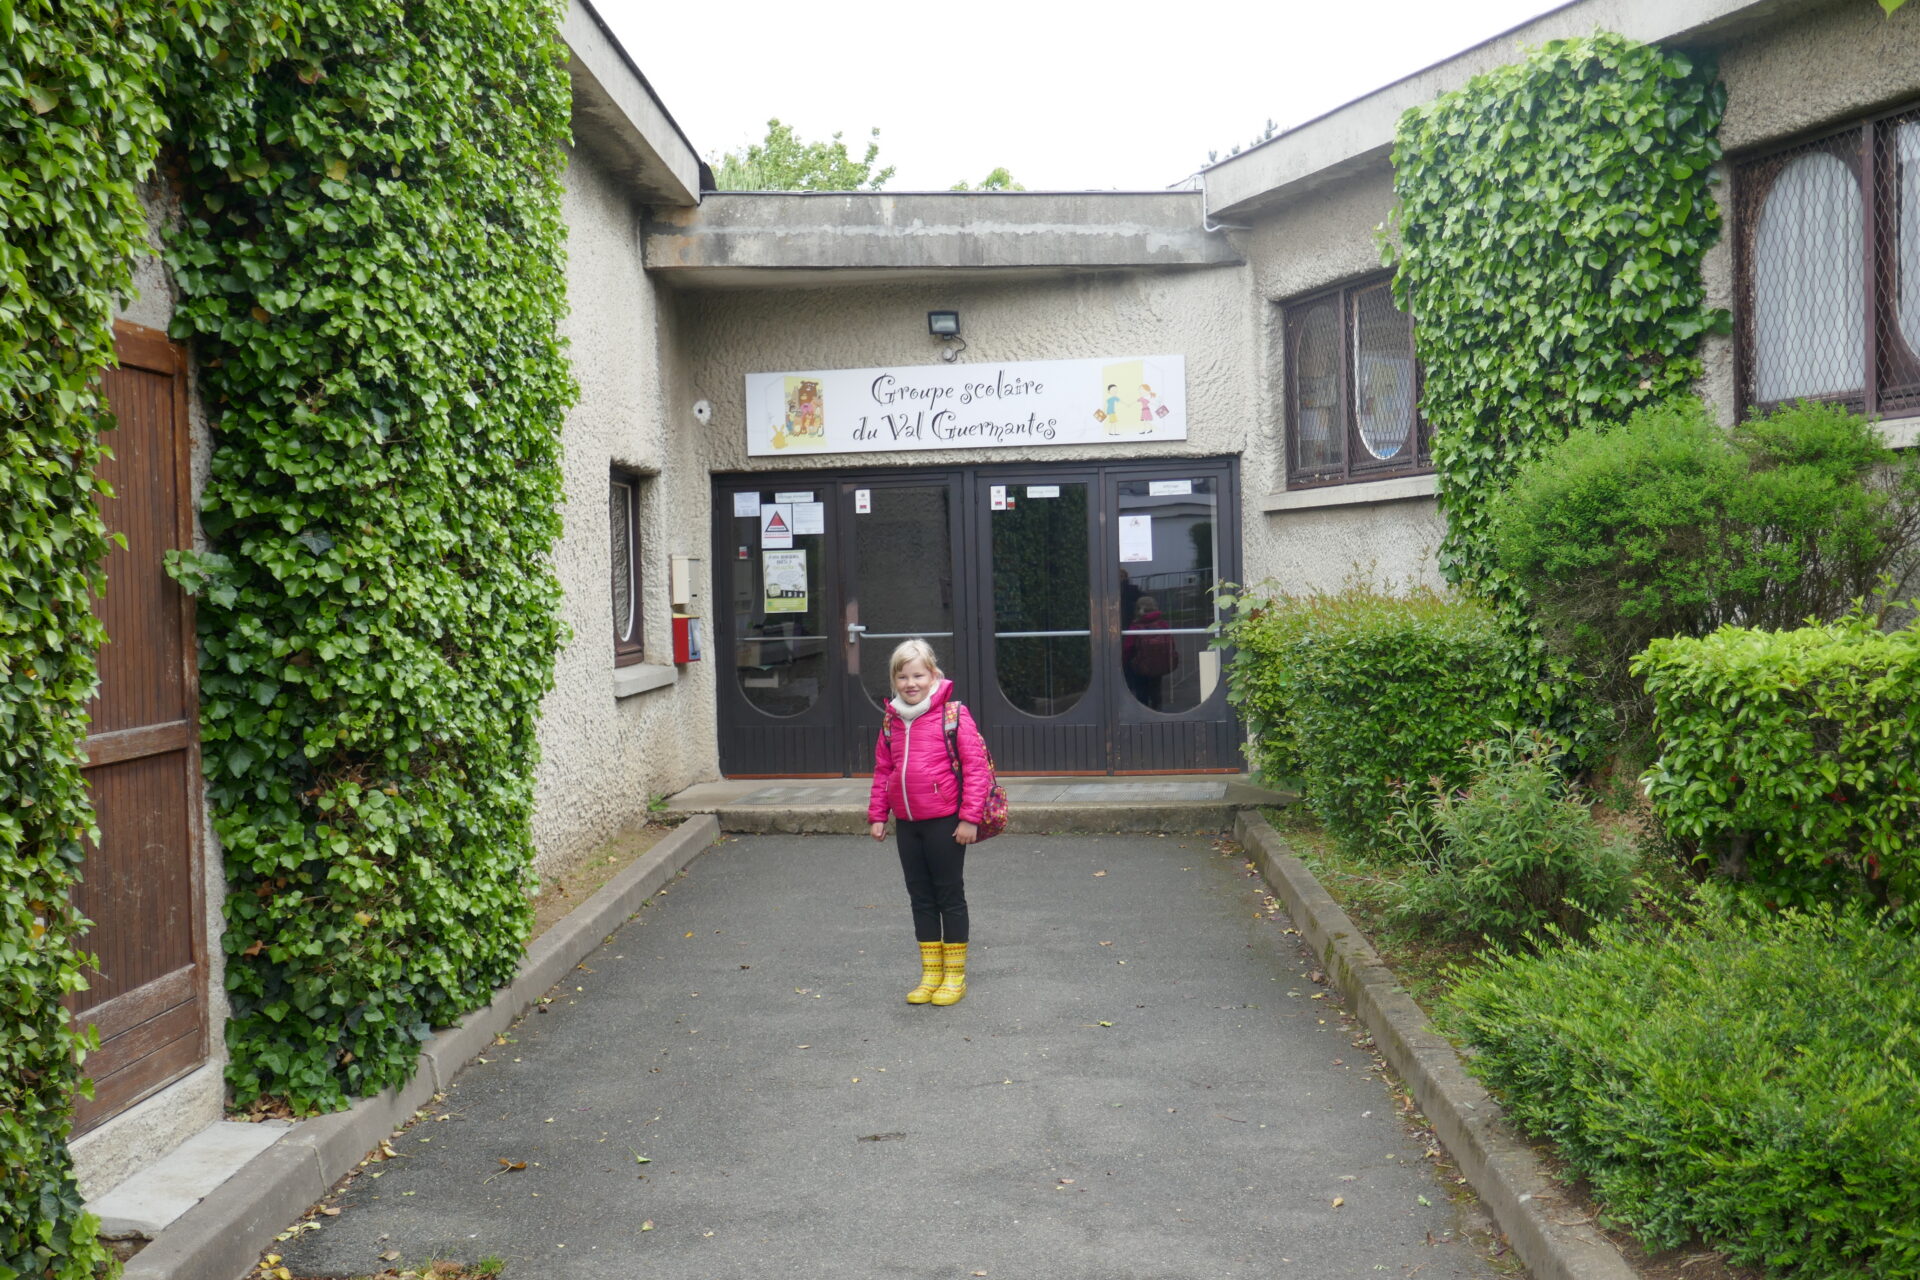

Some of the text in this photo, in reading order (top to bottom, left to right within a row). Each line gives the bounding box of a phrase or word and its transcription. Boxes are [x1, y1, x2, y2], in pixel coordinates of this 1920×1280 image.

[871, 369, 1044, 411] Groupe scolaire
[852, 408, 1057, 443] du Val Guermantes
